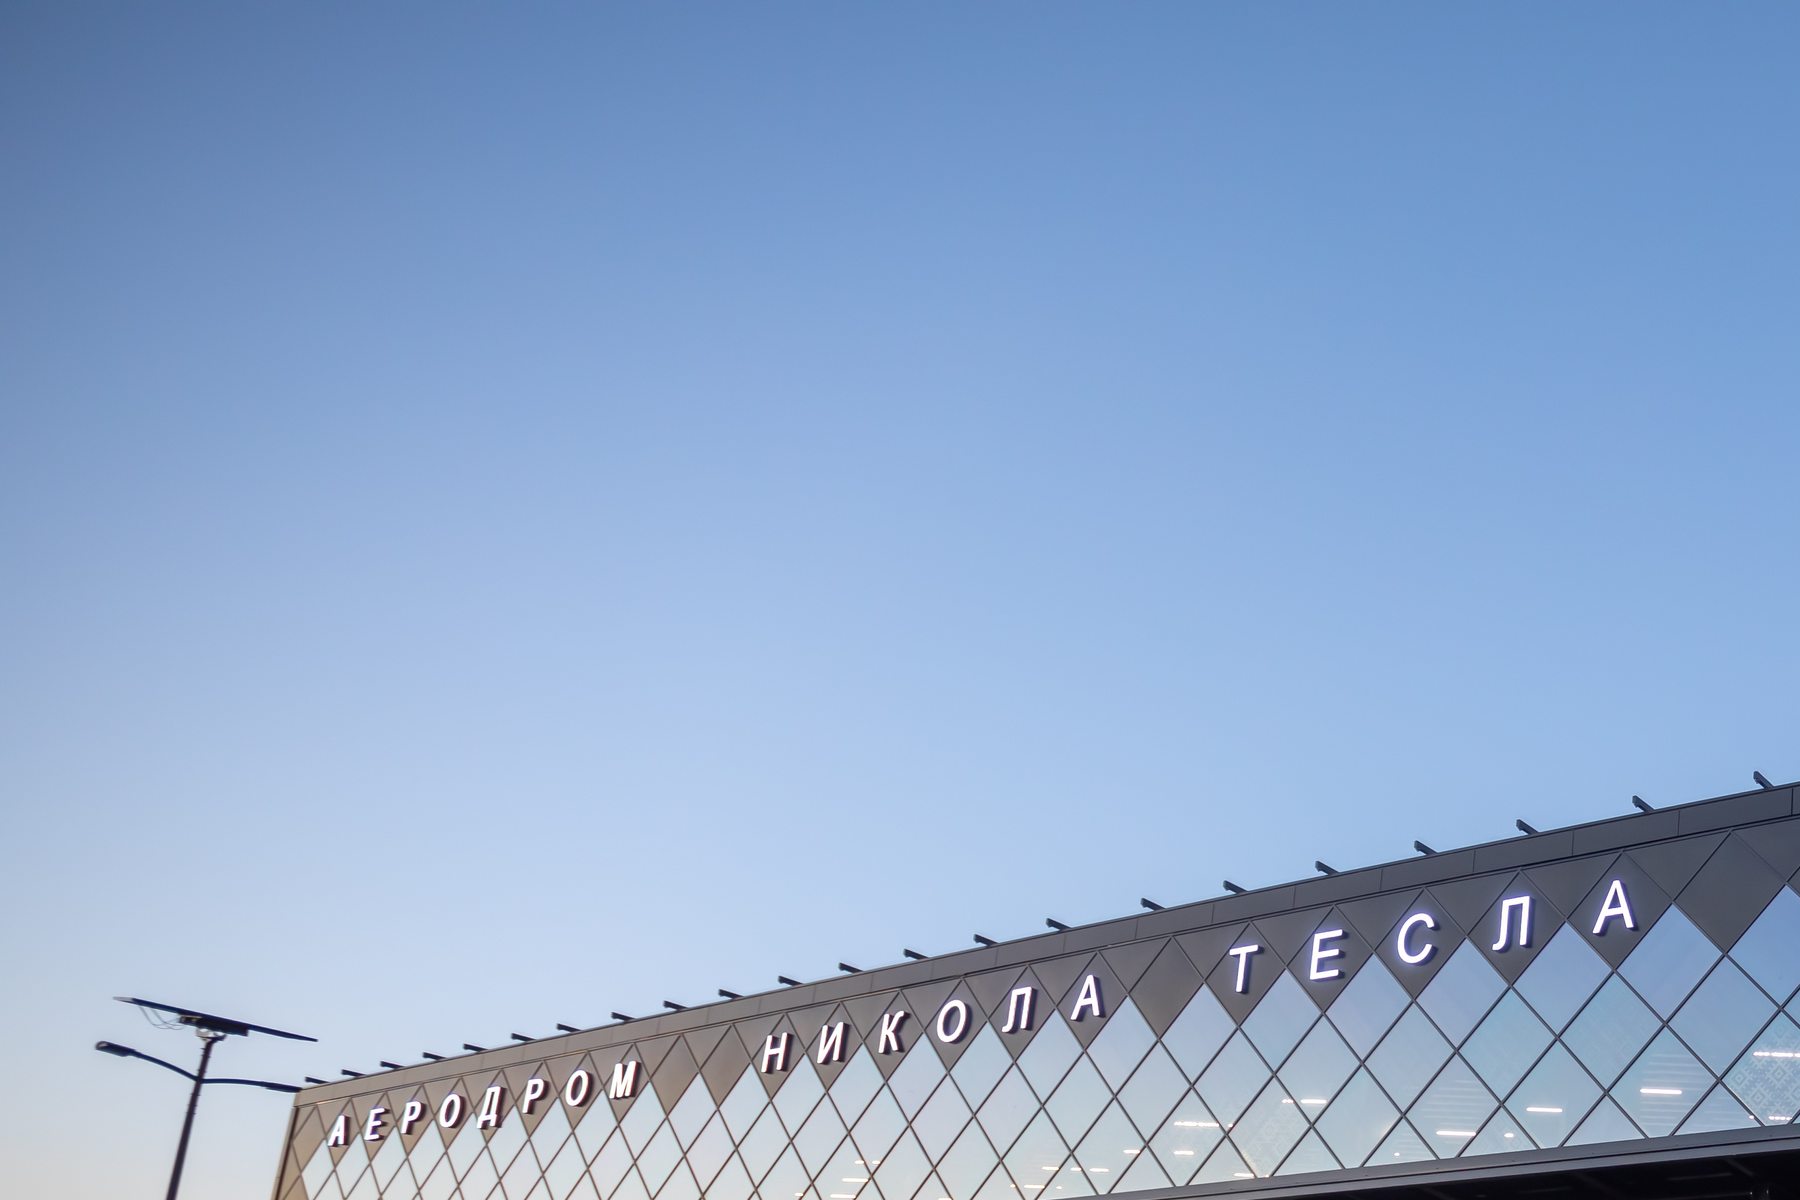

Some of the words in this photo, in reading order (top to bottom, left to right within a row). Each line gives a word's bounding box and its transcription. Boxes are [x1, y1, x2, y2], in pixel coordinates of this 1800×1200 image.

[327, 1059, 640, 1147] АЕРОДРОМ
[760, 974, 1102, 1073] НИКОЛА
[1229, 879, 1636, 994] ТЕСЛА
